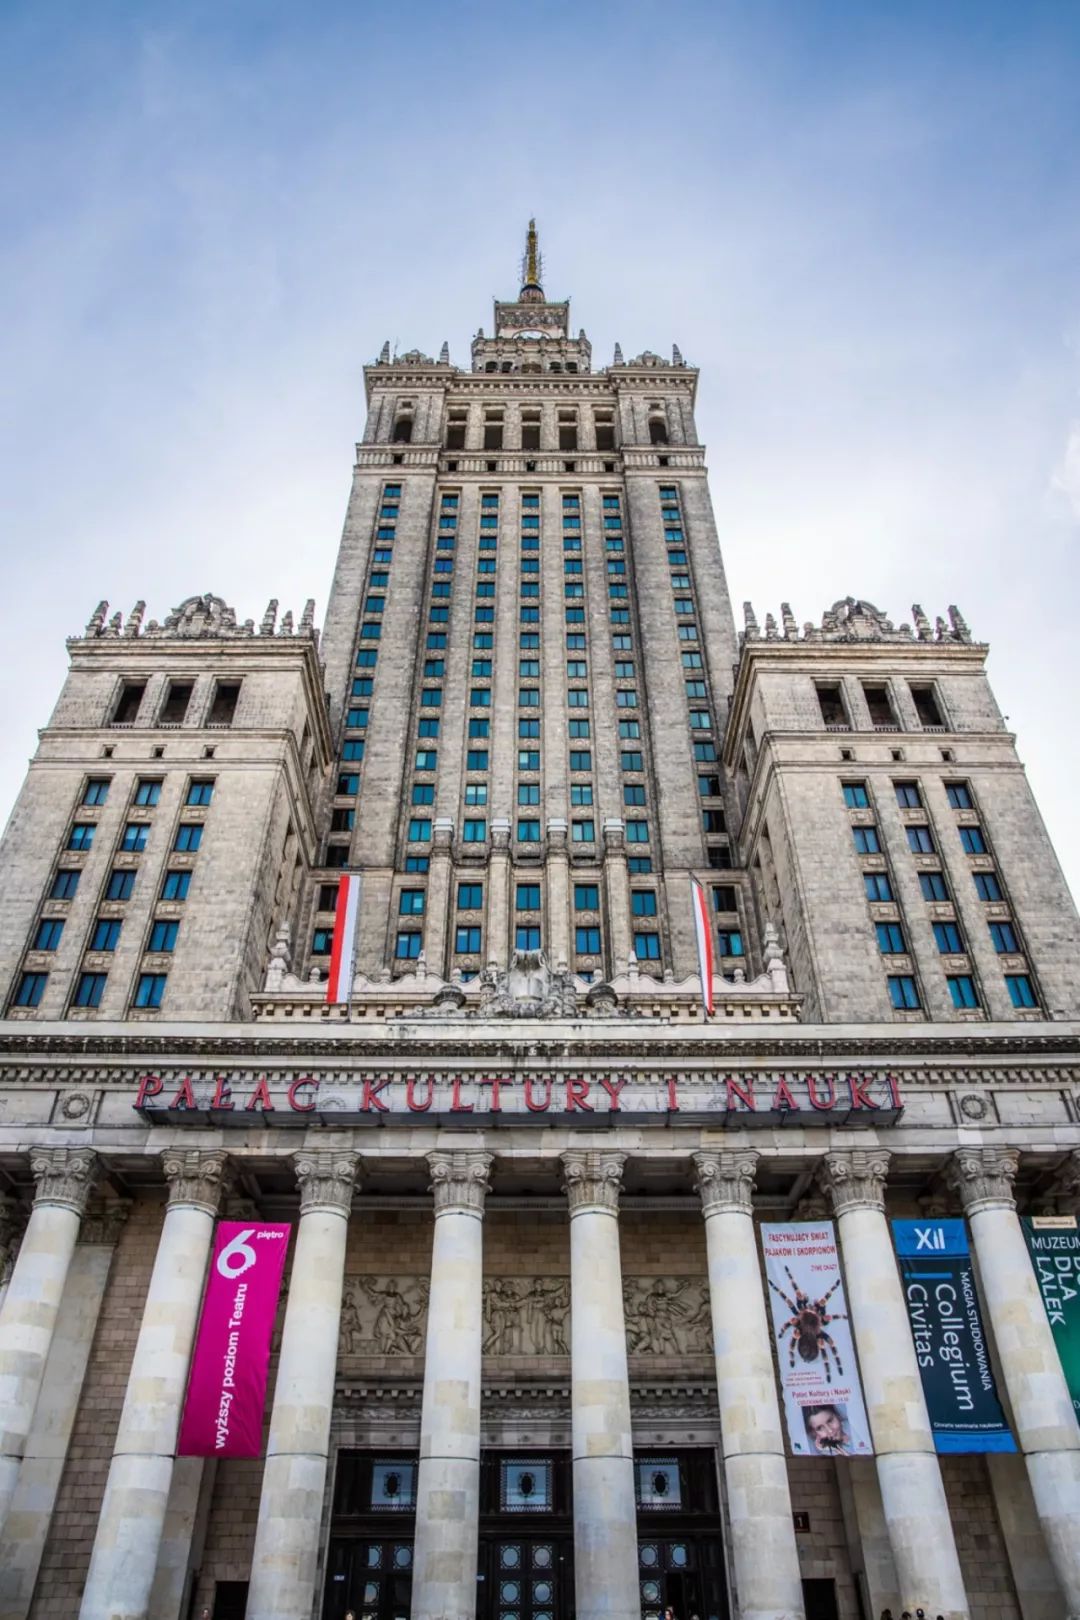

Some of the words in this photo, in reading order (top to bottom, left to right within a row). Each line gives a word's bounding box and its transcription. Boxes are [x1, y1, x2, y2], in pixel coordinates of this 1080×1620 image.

[133, 1075, 320, 1112] PAŁAC
[360, 1076, 628, 1112] KULTURY
[665, 1077, 680, 1112] I
[724, 1072, 904, 1112] NAUKI
[217, 1229, 257, 1280] 6
[913, 1228, 946, 1250] XII
[959, 1271, 975, 1308] MAGIA
[1036, 1256, 1066, 1326] LALEK
[1054, 1256, 1078, 1301] DLA
[228, 1283, 248, 1329] Teatru
[907, 1283, 934, 1368] Civitas
[223, 1332, 240, 1387] poziom
[935, 1283, 974, 1411] Collegium
[966, 1309, 992, 1391] STUDIOWANIA
[215, 1390, 234, 1449] wyższy
